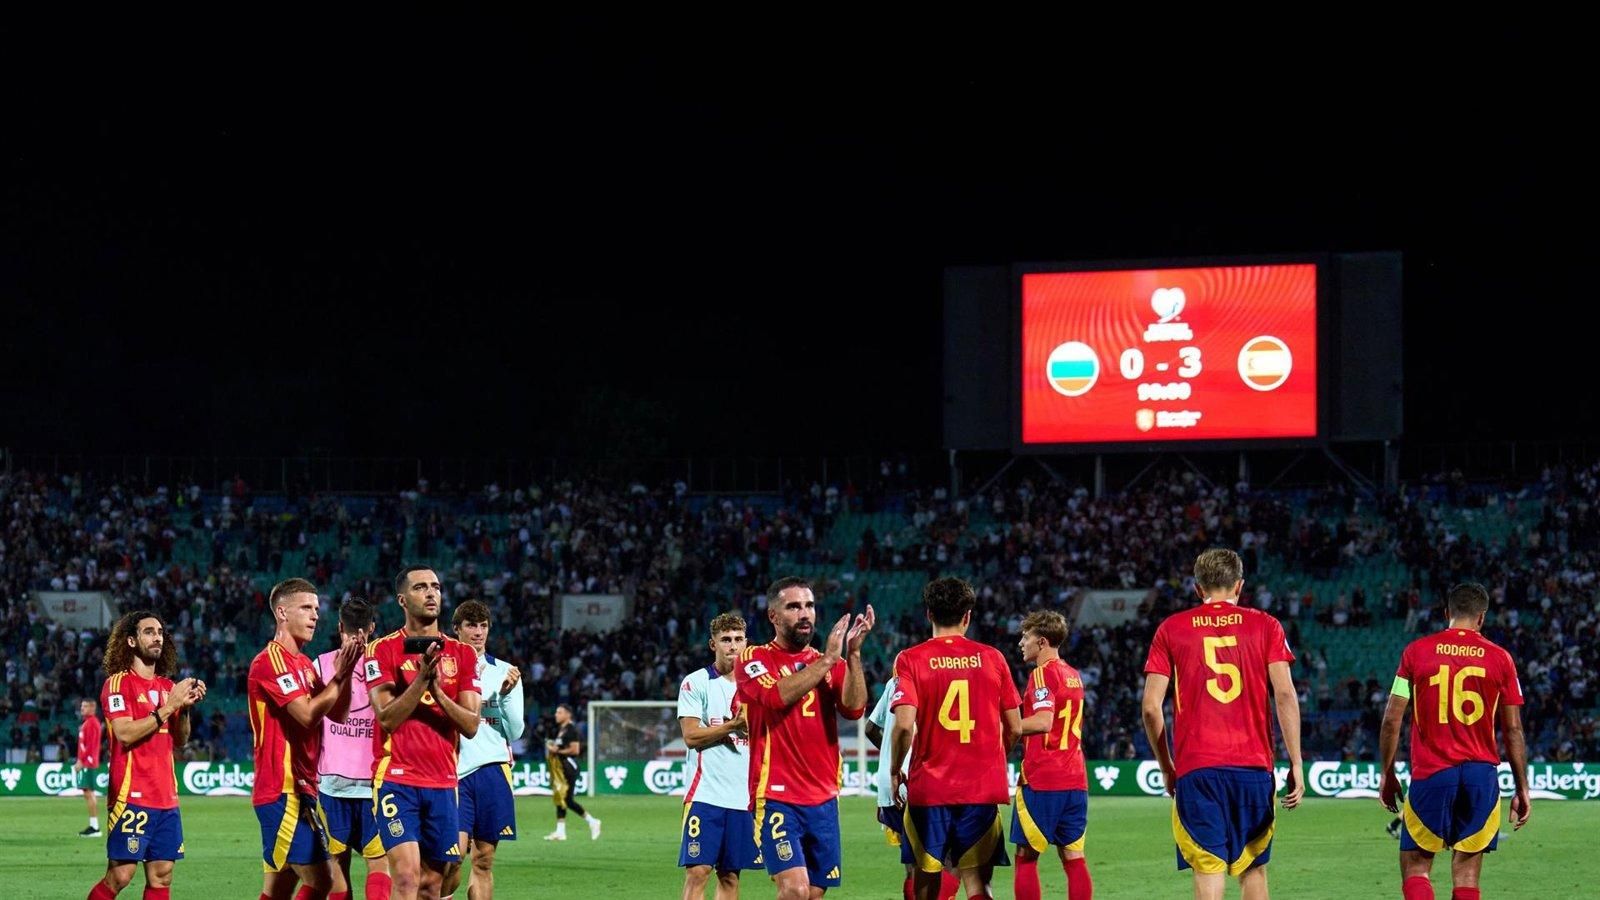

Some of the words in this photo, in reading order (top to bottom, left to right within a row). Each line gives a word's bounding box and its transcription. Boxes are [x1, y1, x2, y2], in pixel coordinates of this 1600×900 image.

[1119, 347, 1145, 380] 0
[1178, 346, 1203, 378] 3
[1192, 613, 1242, 629] HUIJSEN
[928, 652, 982, 669] CUBARSÍ
[1436, 643, 1485, 658] RODRIGO
[1202, 635, 1243, 705] 5
[801, 690, 816, 717] 2
[1429, 664, 1486, 726] 16
[938, 679, 976, 744] 4
[330, 723, 375, 738] QUALIFIE
[36, 762, 109, 796] Carle
[183, 761, 255, 796] Carlsbe
[1308, 761, 1411, 798] Carlsb
[1498, 762, 1600, 800] alsberg
[382, 793, 399, 818] 6
[121, 809, 148, 834] 22
[688, 815, 701, 837] 8
[768, 812, 786, 839] 2
